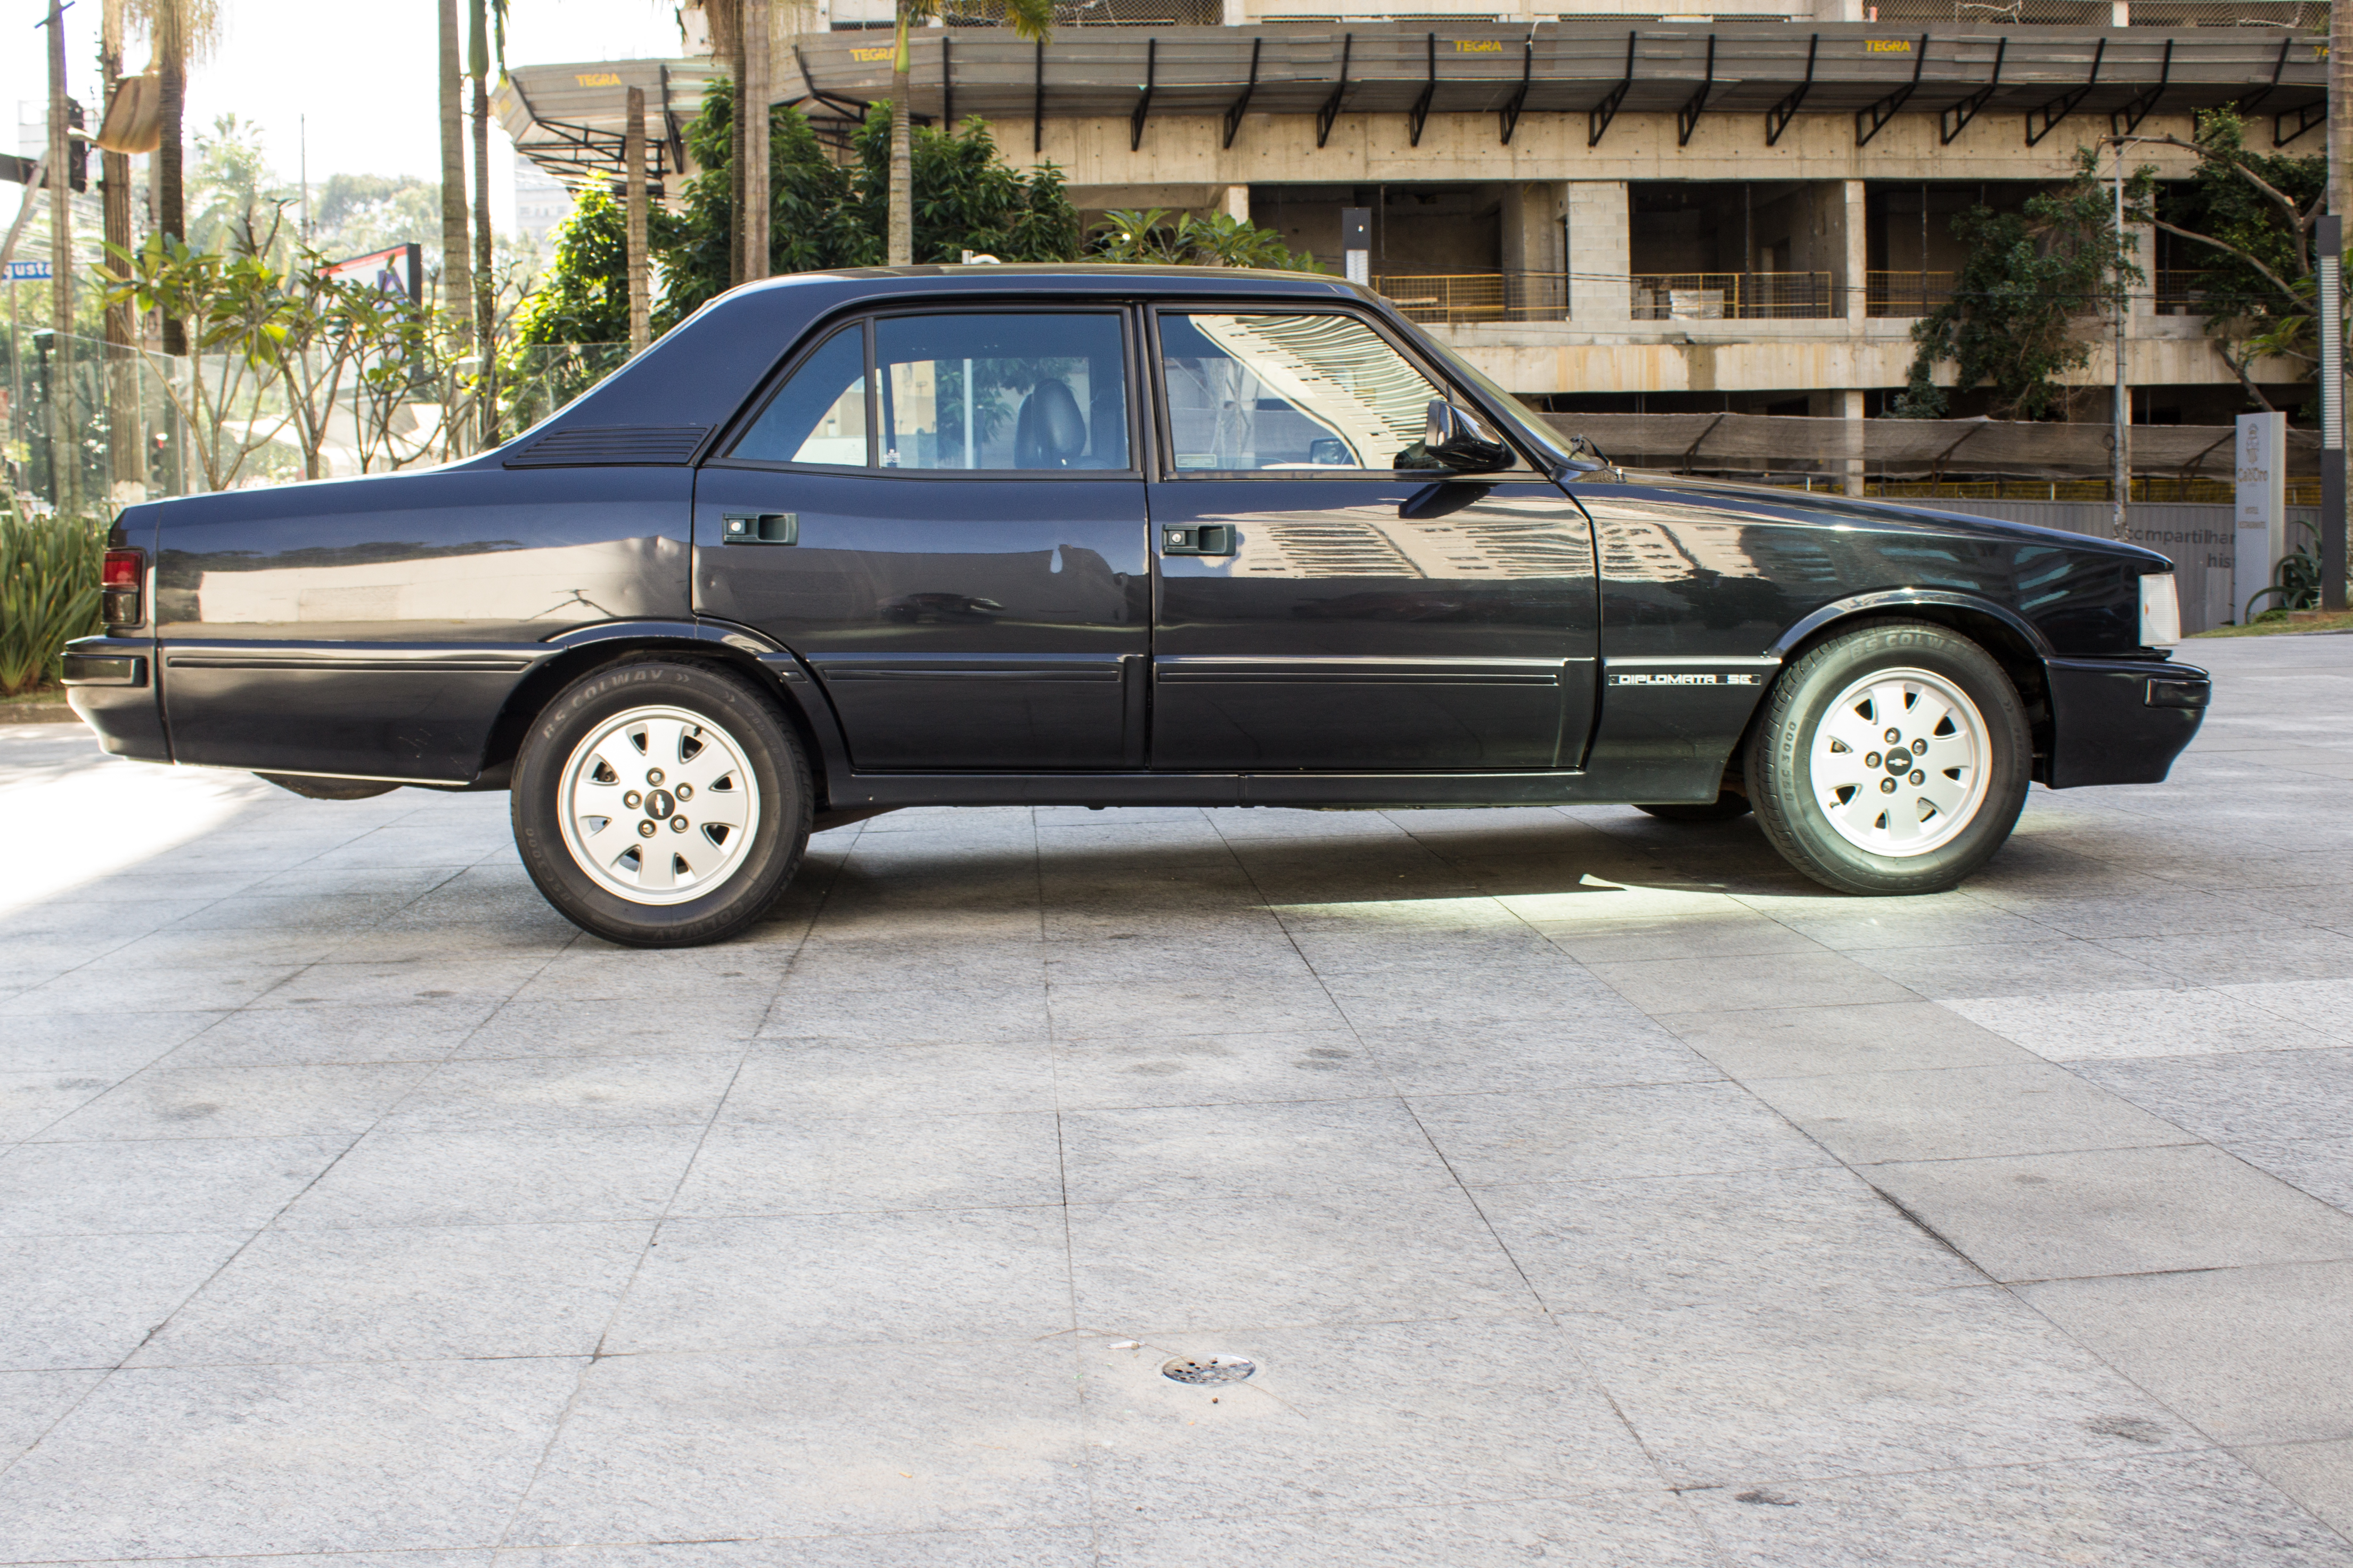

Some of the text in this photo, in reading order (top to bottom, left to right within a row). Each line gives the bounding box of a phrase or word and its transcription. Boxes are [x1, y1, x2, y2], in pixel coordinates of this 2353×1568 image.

[1453, 40, 1502, 52] TEGRA
[1865, 40, 1910, 52] TEGRA
[575, 73, 622, 87] TEGRA
[2207, 553, 2234, 568] his
[1885, 633, 1968, 659] COLWA
[1619, 674, 1752, 684] DIPLOMATA SE
[1781, 720, 1796, 764] 3000
